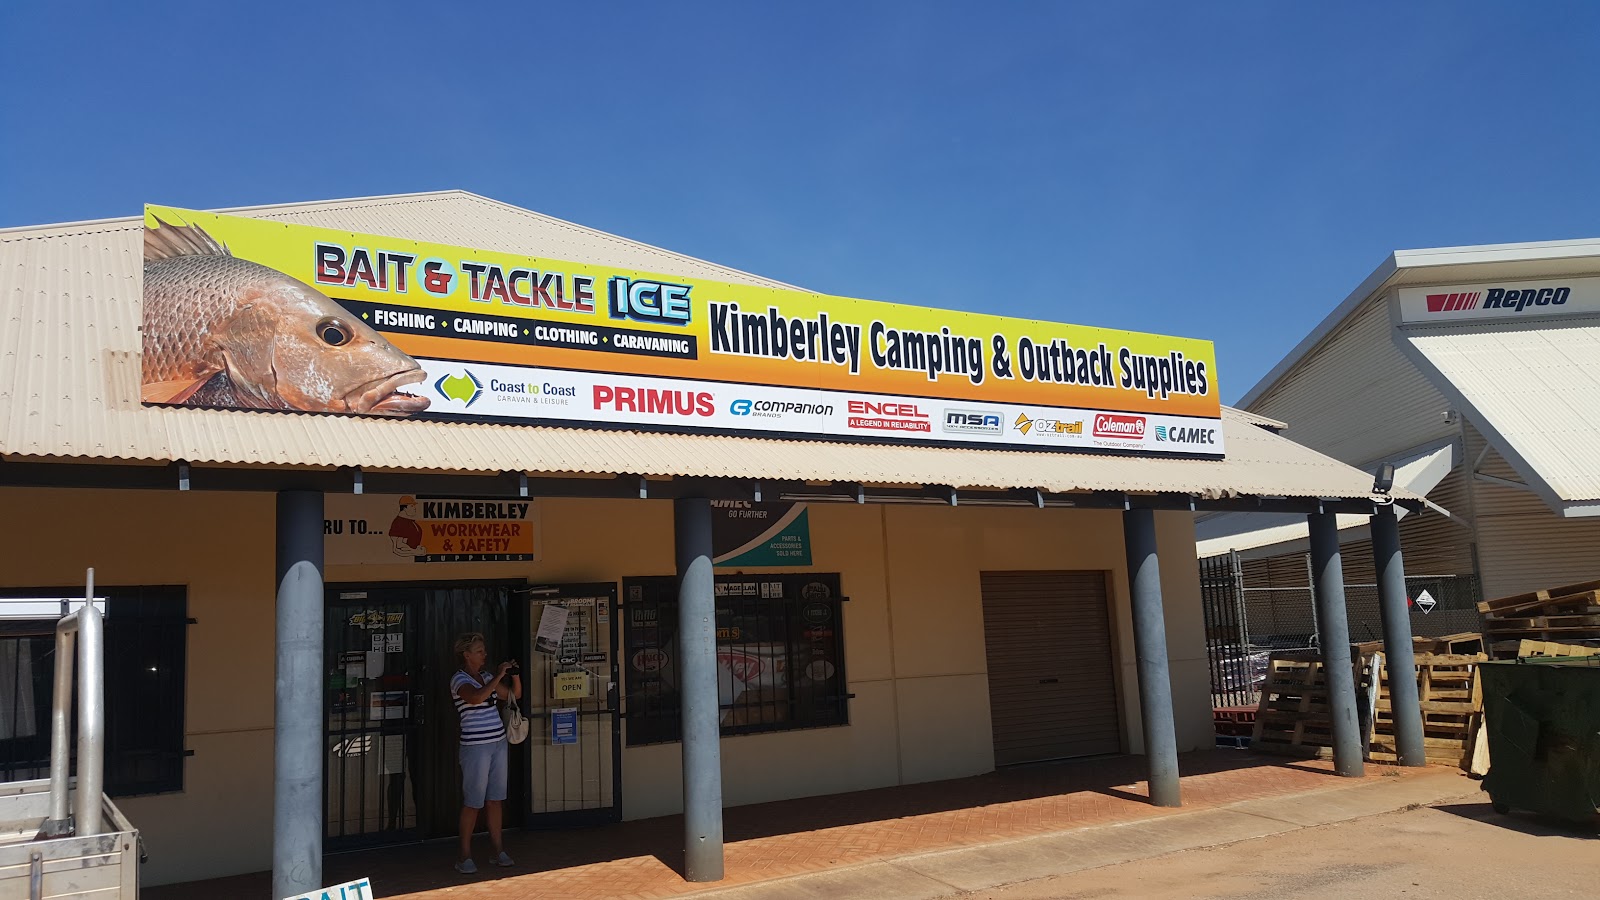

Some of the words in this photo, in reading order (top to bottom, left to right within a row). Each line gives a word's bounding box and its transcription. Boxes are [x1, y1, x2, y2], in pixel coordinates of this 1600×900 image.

[315, 241, 417, 292] BAIT
[423, 260, 453, 294] &
[460, 260, 595, 314] TACKLE
[608, 275, 693, 326] ICE
[1482, 287, 1571, 312] Repco
[374, 309, 436, 331] FISHING
[453, 317, 519, 338] CAMPING
[534, 325, 598, 346] CLOTHING
[613, 334, 690, 354] CARAVANING
[708, 301, 862, 375] Kimberley
[870, 321, 984, 384] Camping
[992, 334, 1014, 379] &
[1018, 337, 1116, 387] Outback
[1118, 347, 1208, 399] Supplies
[490, 378, 525, 393] Coast
[527, 382, 540, 394] to
[542, 382, 576, 397] Coast
[497, 395, 531, 403] CARAVAN
[540, 397, 569, 406] LEISURE
[592, 384, 714, 417] PRIMUS
[752, 411, 782, 419] BRANDS
[847, 400, 930, 418] ENGEL
[849, 418, 856, 426] A
[856, 419, 883, 428] LEGEND
[883, 420, 890, 428] IN
[891, 421, 928, 430] RELIABILITY
[1096, 415, 1136, 434] Coleman
[1168, 426, 1216, 445] CAMEC
[1103, 440, 1122, 448] Outdoor
[423, 501, 529, 520] KIMBERLEY
[728, 510, 738, 518] GO
[738, 510, 768, 519] FURTHER
[349, 519, 383, 535] TO...
[430, 523, 521, 537] WORKWEAR
[442, 539, 454, 552] &
[459, 538, 511, 552] SAFETY
[426, 554, 524, 562] SUPPLIES
[373, 633, 401, 642] BAIT
[373, 645, 401, 653] HERE
[561, 683, 582, 692] OPEN
